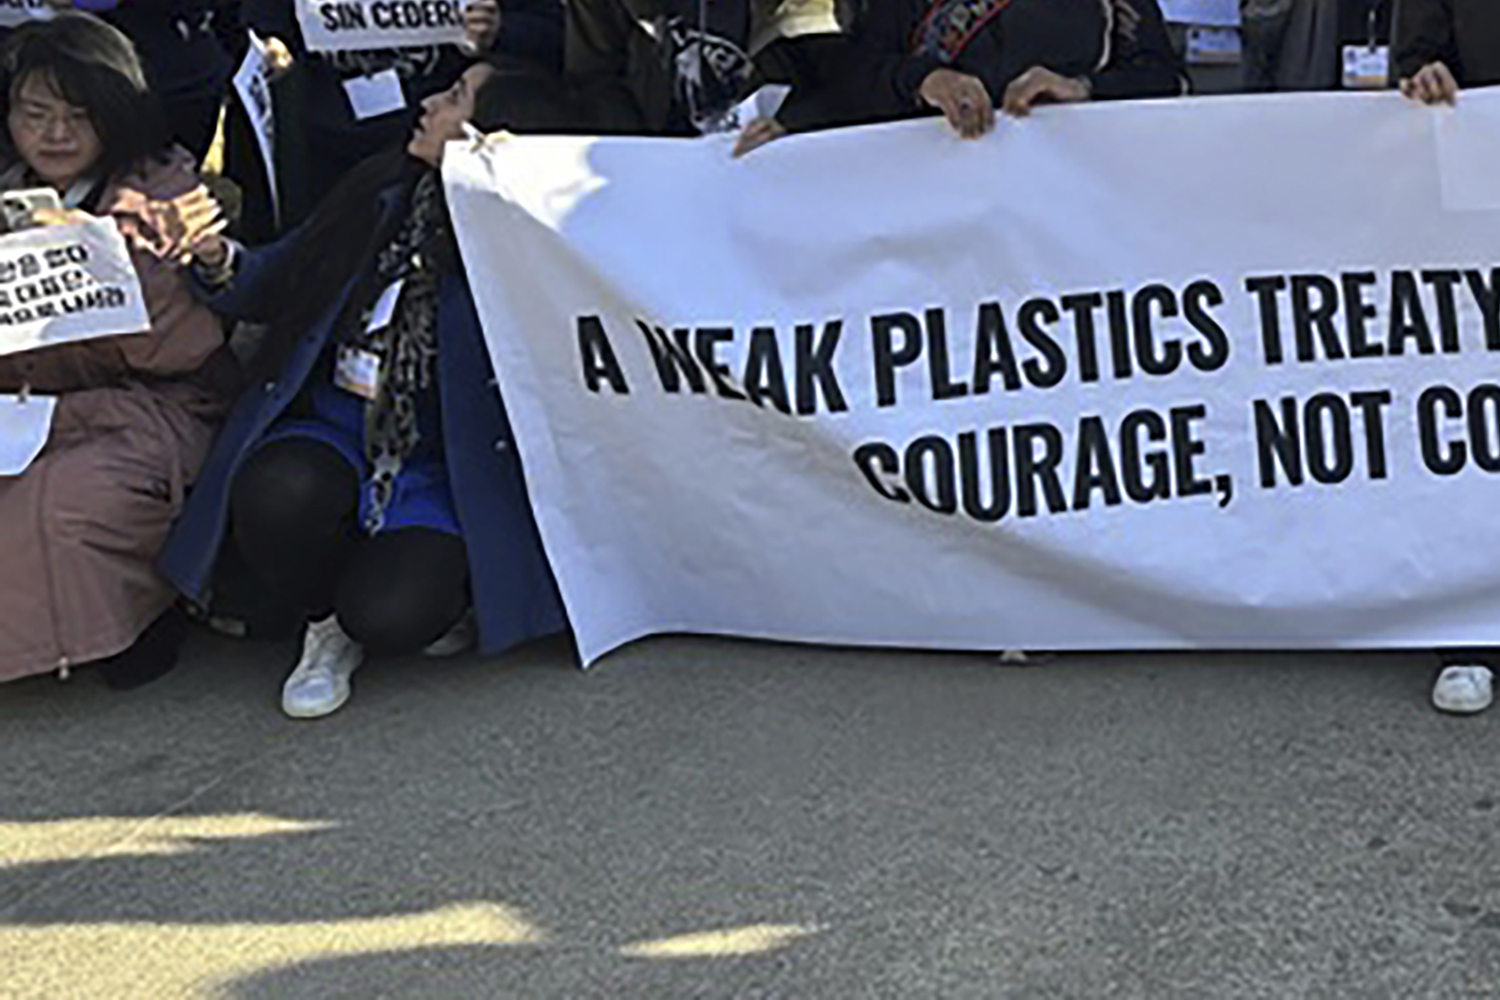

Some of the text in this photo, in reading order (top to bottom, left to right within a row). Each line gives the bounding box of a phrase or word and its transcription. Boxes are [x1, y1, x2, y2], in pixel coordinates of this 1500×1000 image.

[320, 2, 367, 31] SIN
[578, 315, 629, 395] A
[635, 318, 849, 417] WEAK
[870, 279, 1230, 408] PLASTICS
[853, 404, 1233, 523] COURAGE,
[1252, 389, 1392, 489] NOT
